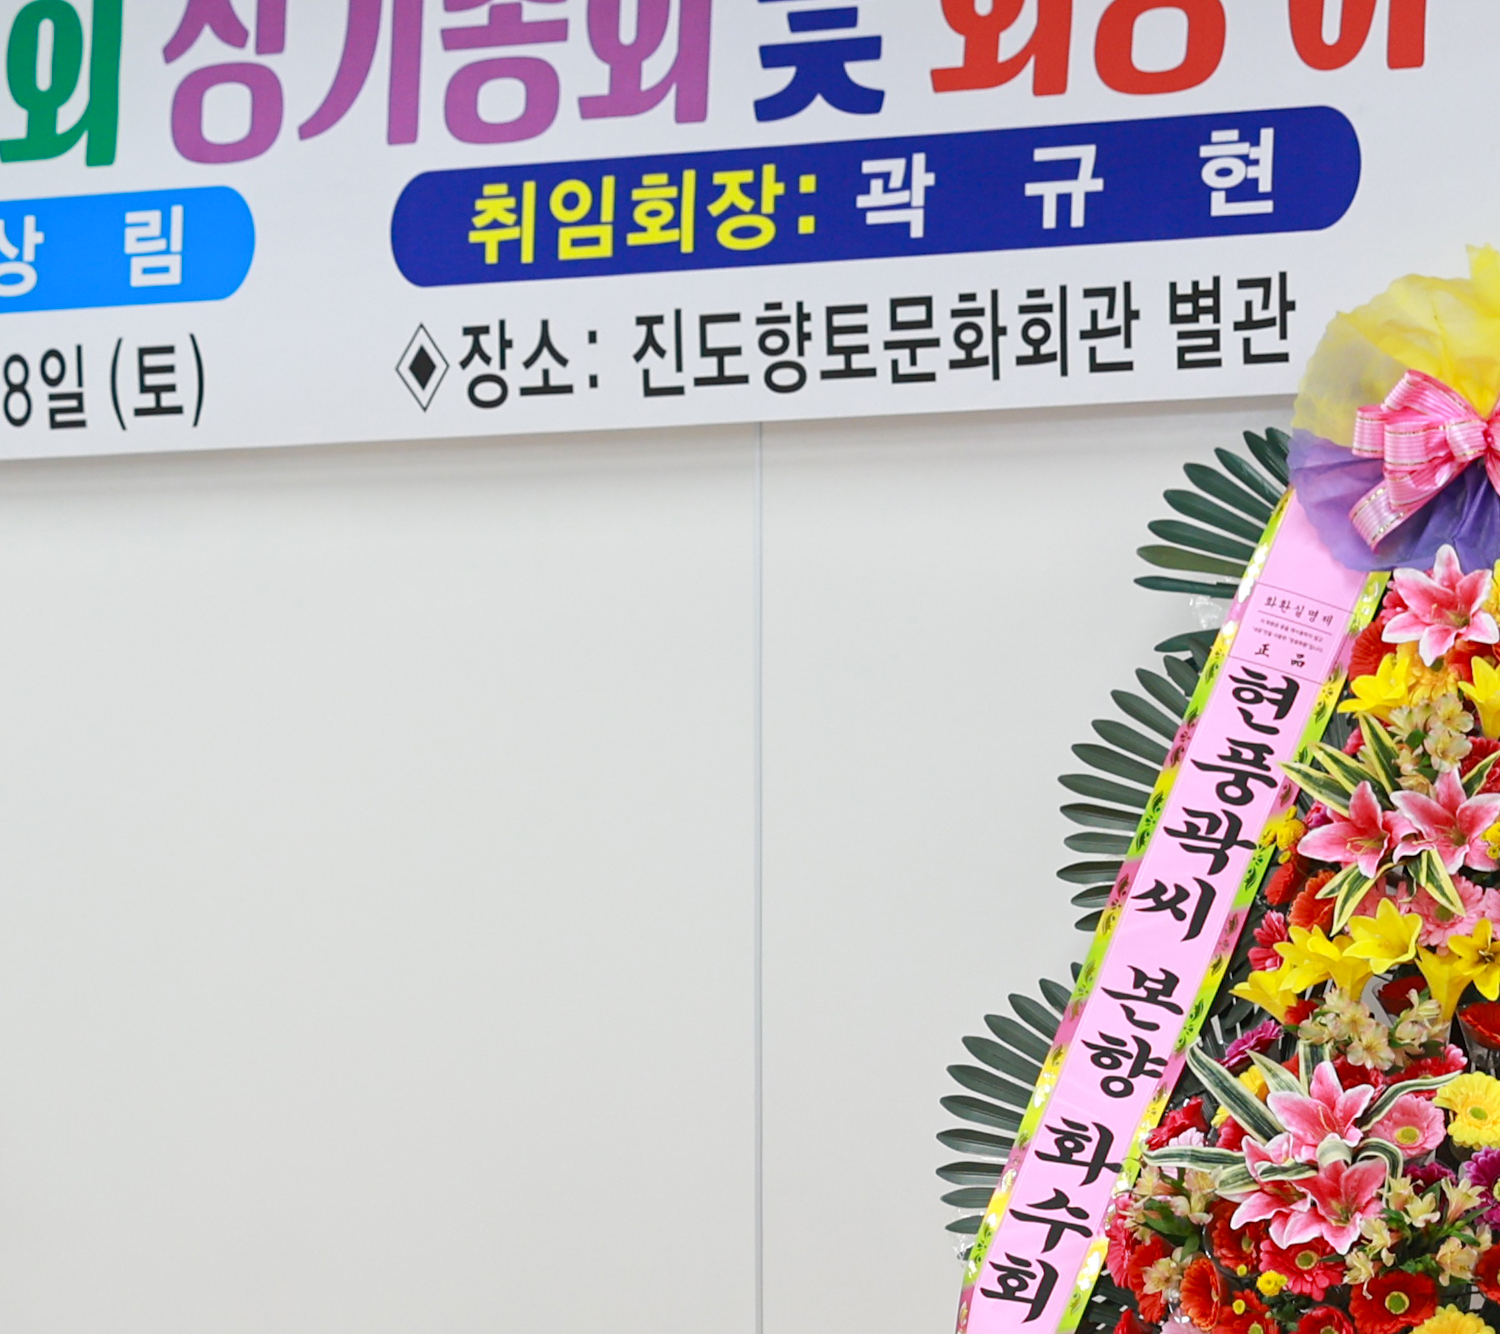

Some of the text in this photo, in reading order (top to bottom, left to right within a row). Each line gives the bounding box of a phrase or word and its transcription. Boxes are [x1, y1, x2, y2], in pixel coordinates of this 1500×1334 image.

[122, 203, 185, 289] 림
[468, 126, 1277, 265] 취임회장: 곽 규 현
[1, 342, 87, 430] 8일
[109, 333, 206, 432] (토)
[458, 270, 1296, 412] 장소: 진도향토문화회관 별관
[1130, 665, 1300, 942] 현풍곽씨
[1081, 964, 1186, 1100] 본향
[980, 1118, 1124, 1325] 화수회
